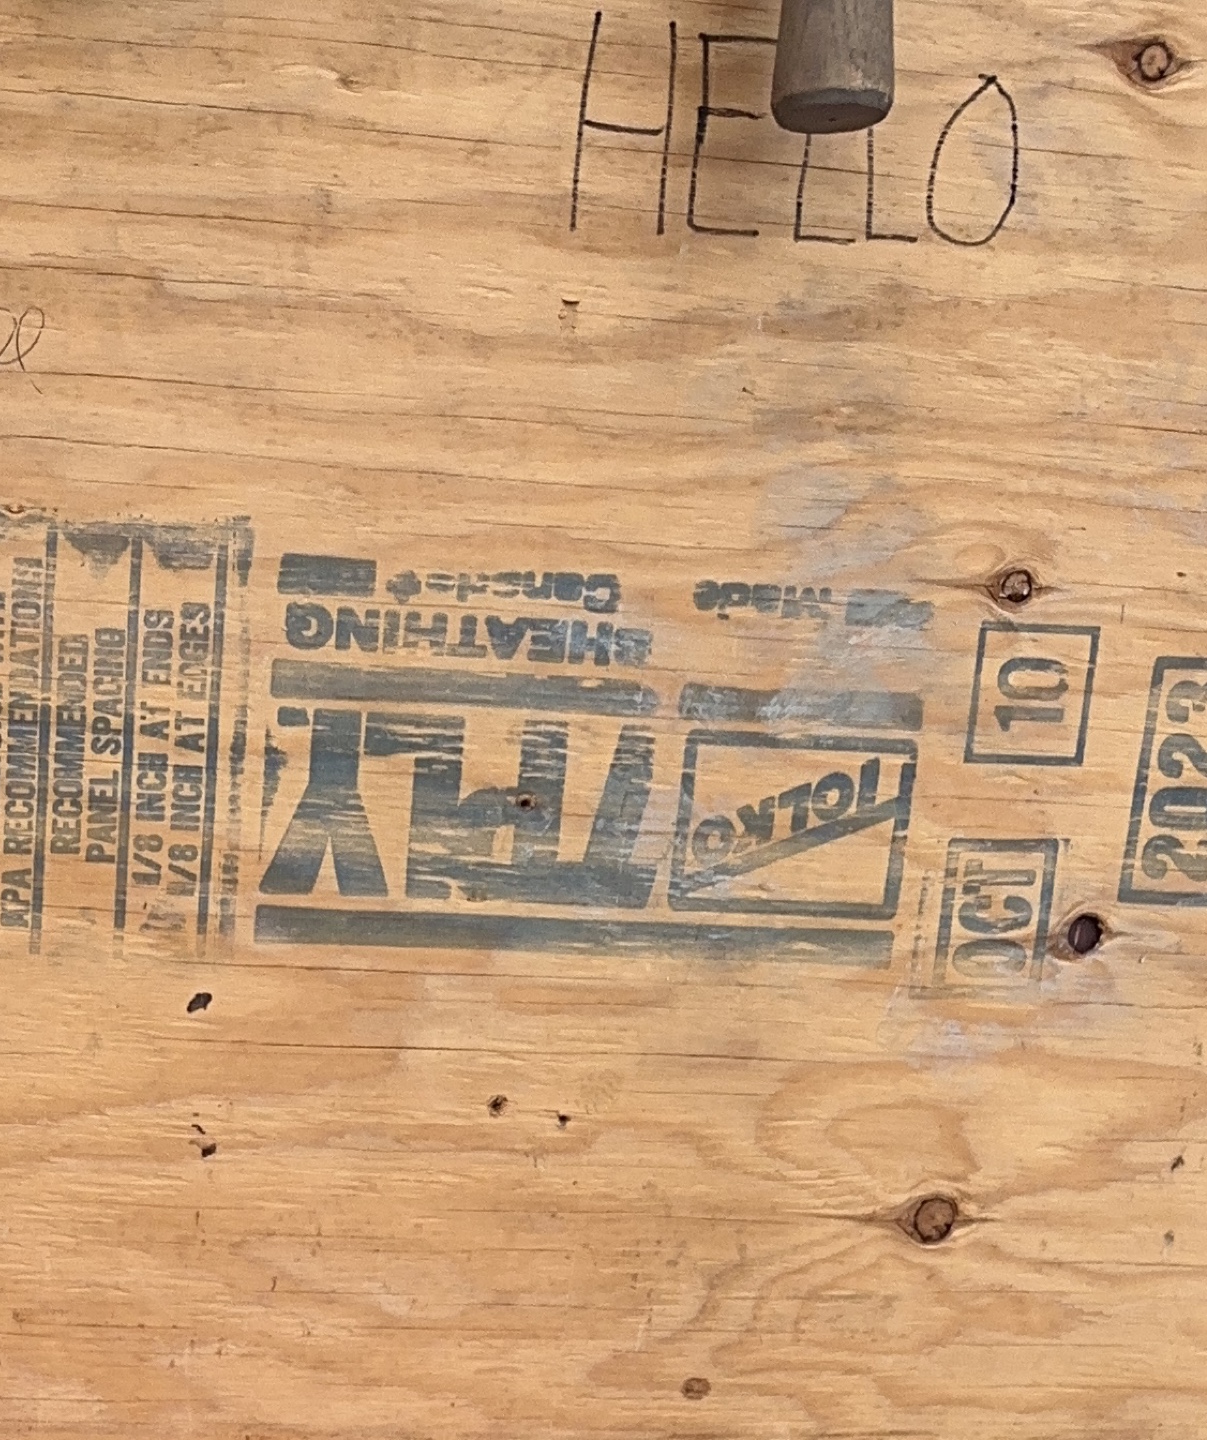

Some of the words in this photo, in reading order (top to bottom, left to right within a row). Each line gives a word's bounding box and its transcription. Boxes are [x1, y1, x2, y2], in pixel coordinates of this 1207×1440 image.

[569, 11, 1019, 246] HELLO
[141, 609, 174, 686] ENDS
[177, 601, 210, 699] EDGES
[284, 602, 652, 668] SHEATHING
[91, 627, 126, 755] SPACING
[139, 701, 169, 741] AT
[174, 710, 205, 753] AT
[993, 658, 1069, 732] 10
[51, 634, 88, 855] RECOMMENDED
[135, 752, 168, 822] INCH
[1141, 680, 1207, 881] 2023
[86, 768, 120, 864] PANEL
[170, 764, 203, 830] INCH
[691, 757, 882, 865] TOLKO
[0, 867, 32, 929] APA
[952, 858, 1036, 978] OCT
